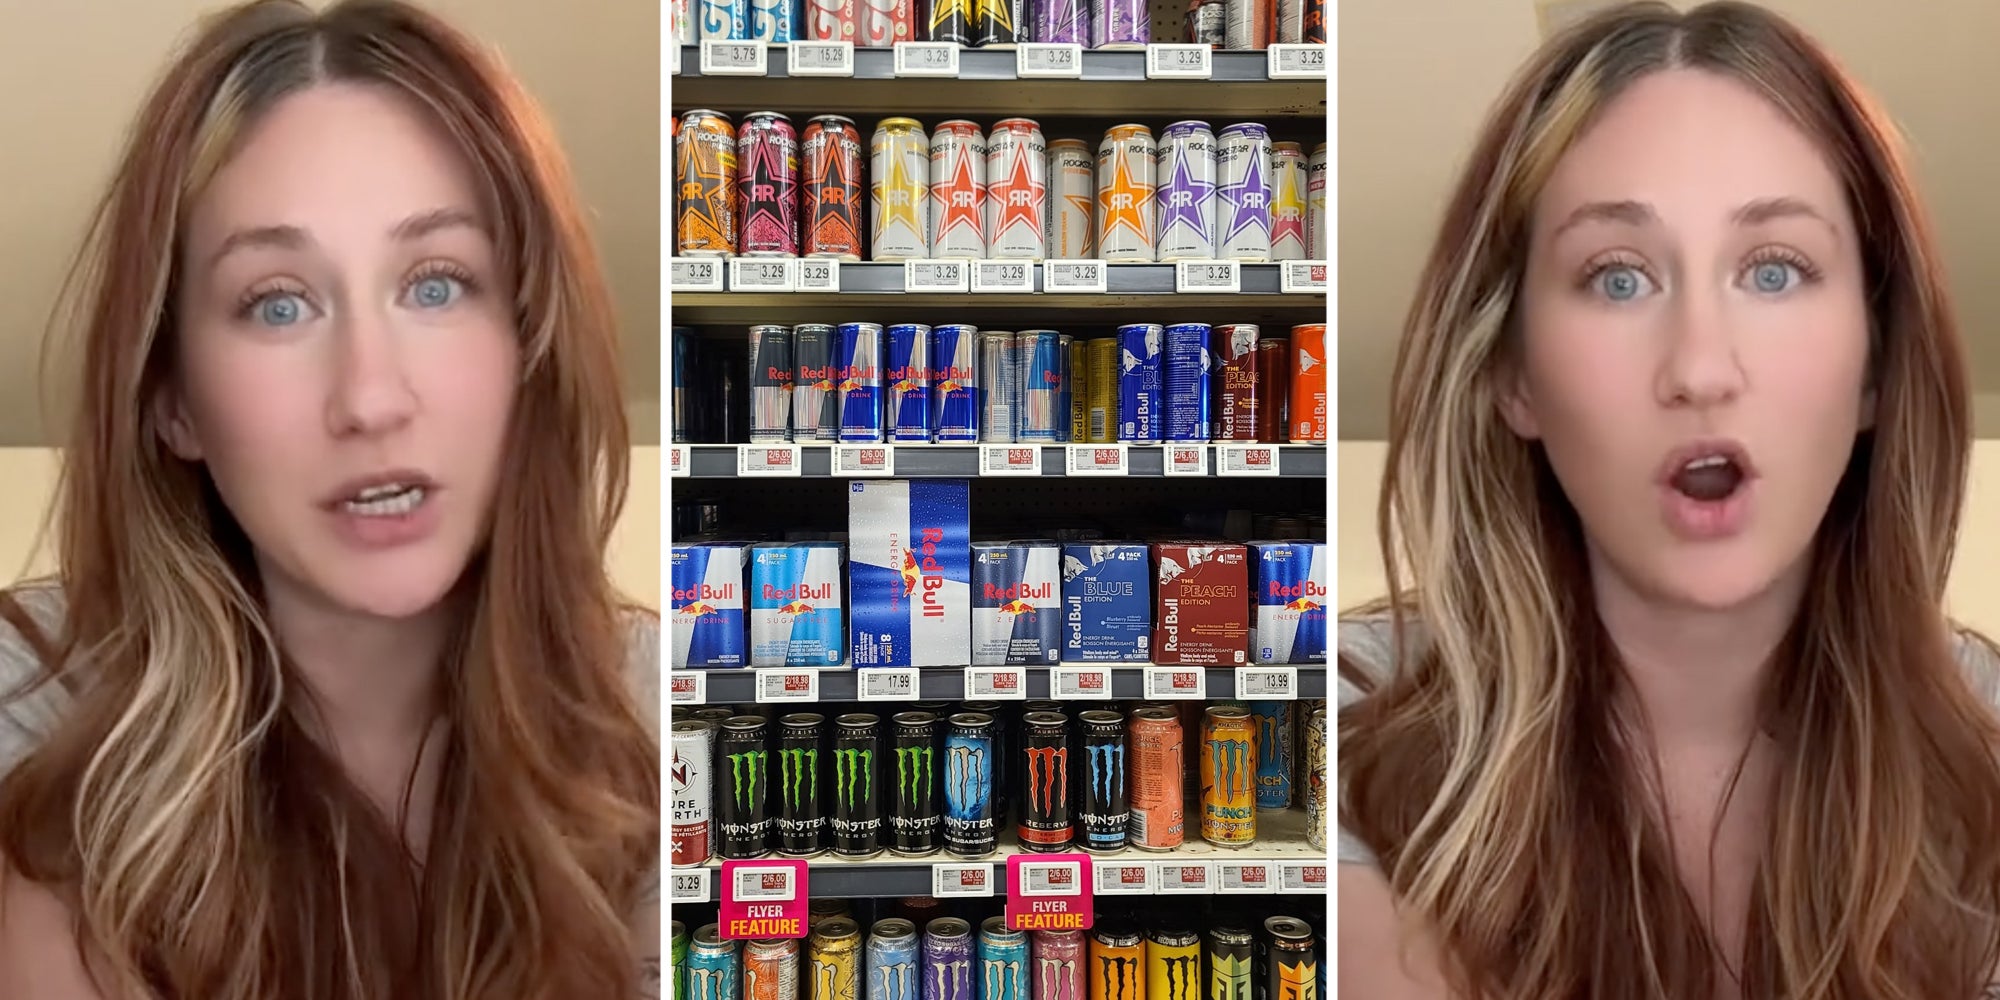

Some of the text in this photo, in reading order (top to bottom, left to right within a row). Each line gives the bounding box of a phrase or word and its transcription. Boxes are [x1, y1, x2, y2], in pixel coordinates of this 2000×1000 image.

[733, 47, 756, 61] 3.79
[820, 47, 843, 62] 15.29
[926, 49, 949, 62] 3.29
[1049, 50, 1071, 63] 3.29
[1179, 50, 1201, 63] 3.29
[1301, 50, 1324, 63] 3.29
[1310, 180, 1324, 189] NEW
[690, 264, 712, 278] 3.29
[762, 265, 784, 278] 3.29
[805, 267, 829, 279] 3.29
[936, 266, 958, 279] 3.29
[1002, 266, 1024, 279] 3.29
[1075, 266, 1097, 279] 3.29
[1208, 266, 1230, 279] 3.29
[801, 366, 826, 379] Red
[850, 366, 874, 379] Bull
[950, 366, 973, 379] Bull
[1075, 400, 1083, 441] Red Bull
[1137, 393, 1149, 439] Red Bull
[1223, 393, 1234, 439] Red Bull
[1314, 393, 1326, 439] Red Bull
[768, 450, 792, 459] 2/6.00
[861, 450, 884, 458] 2/6.00
[1009, 450, 1032, 458] 2/6.00
[1096, 450, 1119, 458] 2/6.00
[1174, 451, 1198, 460] 2/6.00
[1247, 450, 1270, 459] 2/6.00
[757, 553, 766, 565] 4
[978, 553, 987, 564] 4
[1118, 552, 1126, 561] 4
[1217, 555, 1224, 564] 4
[1263, 551, 1272, 561] 4
[921, 528, 945, 617] Red Bull
[701, 583, 733, 599] Bull
[763, 583, 831, 600] Red Bull
[984, 582, 1051, 600] Red Bull
[1084, 581, 1133, 596] BLUE
[1180, 585, 1237, 598] PEACH
[1269, 580, 1302, 597] Red
[1068, 596, 1081, 648] Red Bull
[1165, 599, 1178, 652] Red Bull
[880, 634, 891, 642] 8
[786, 676, 809, 684] 2/18.98
[888, 675, 909, 688] 17.99
[994, 673, 1017, 682] 2/18.98
[1080, 674, 1103, 682] 2/18.98
[1173, 673, 1195, 682] 2/18.98
[1267, 675, 1288, 687] 13.99
[1206, 806, 1253, 819] PUNCH
[889, 814, 941, 828] MONSTER
[684, 825, 704, 833] SELTZER
[962, 870, 985, 879] 2/6.00
[1049, 869, 1071, 878] 2/6.00
[1122, 868, 1144, 877] 2/6.00
[1182, 867, 1205, 876] 2/6.00
[1242, 867, 1265, 876] 2/6.00
[1303, 867, 1326, 876] 2/6.00
[678, 876, 700, 889] 3.29
[762, 874, 786, 883] 2/6.00
[748, 905, 783, 917] FLYER
[1033, 901, 1067, 912] FLYER
[730, 919, 800, 936] FEATURE
[1016, 914, 1084, 928] FEATURE
